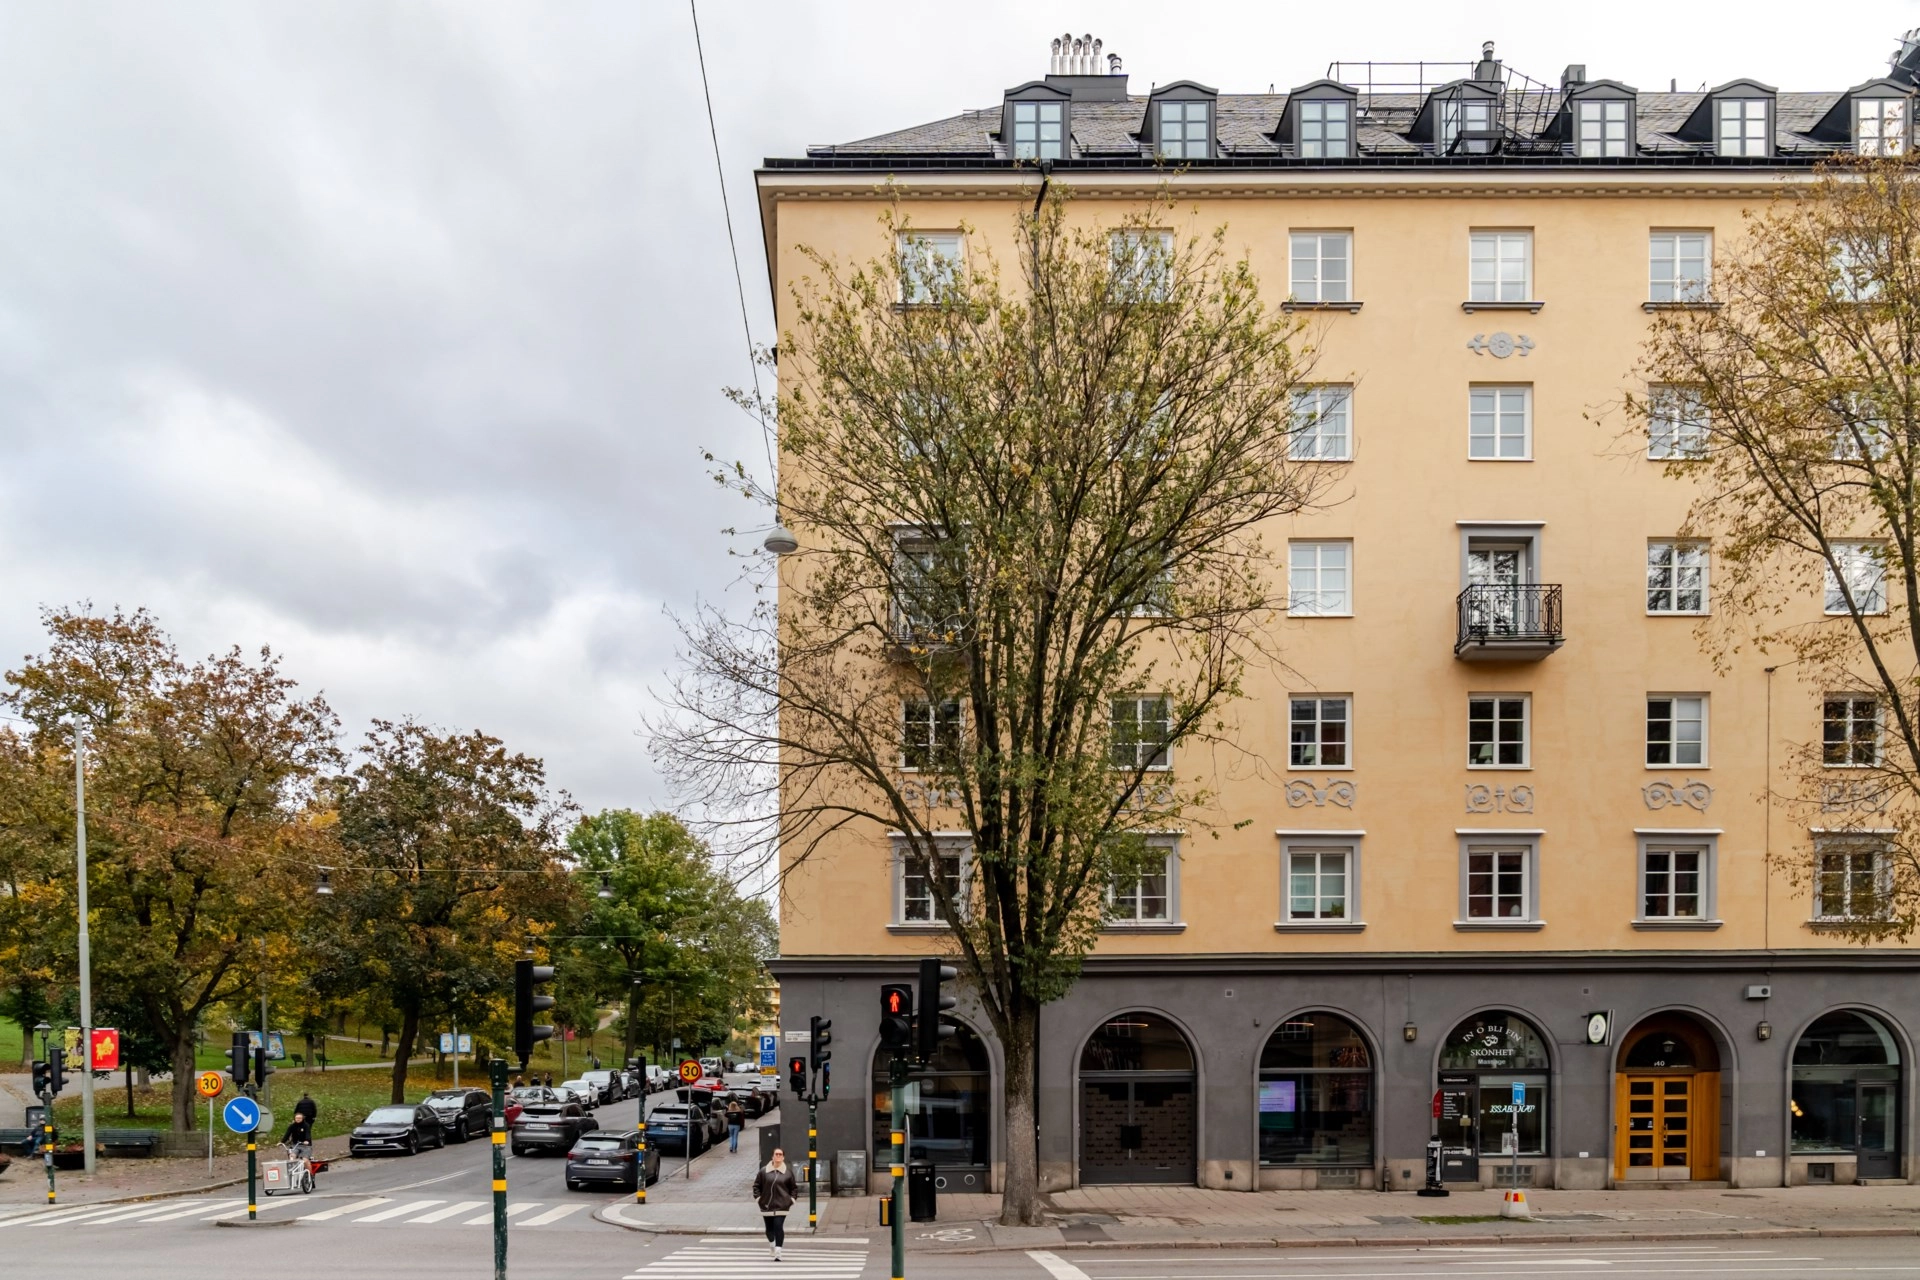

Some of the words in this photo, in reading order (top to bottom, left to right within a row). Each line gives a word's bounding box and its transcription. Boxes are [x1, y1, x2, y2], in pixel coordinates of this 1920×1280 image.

[1463, 1031, 1474, 1042] IN
[1488, 1025, 1503, 1033] BLI
[1505, 1029, 1522, 1042] FIN
[763, 1036, 773, 1050] P
[1470, 1048, 1514, 1056] SKÖNHET
[683, 1066, 699, 1076] 30
[203, 1078, 218, 1089] 30
